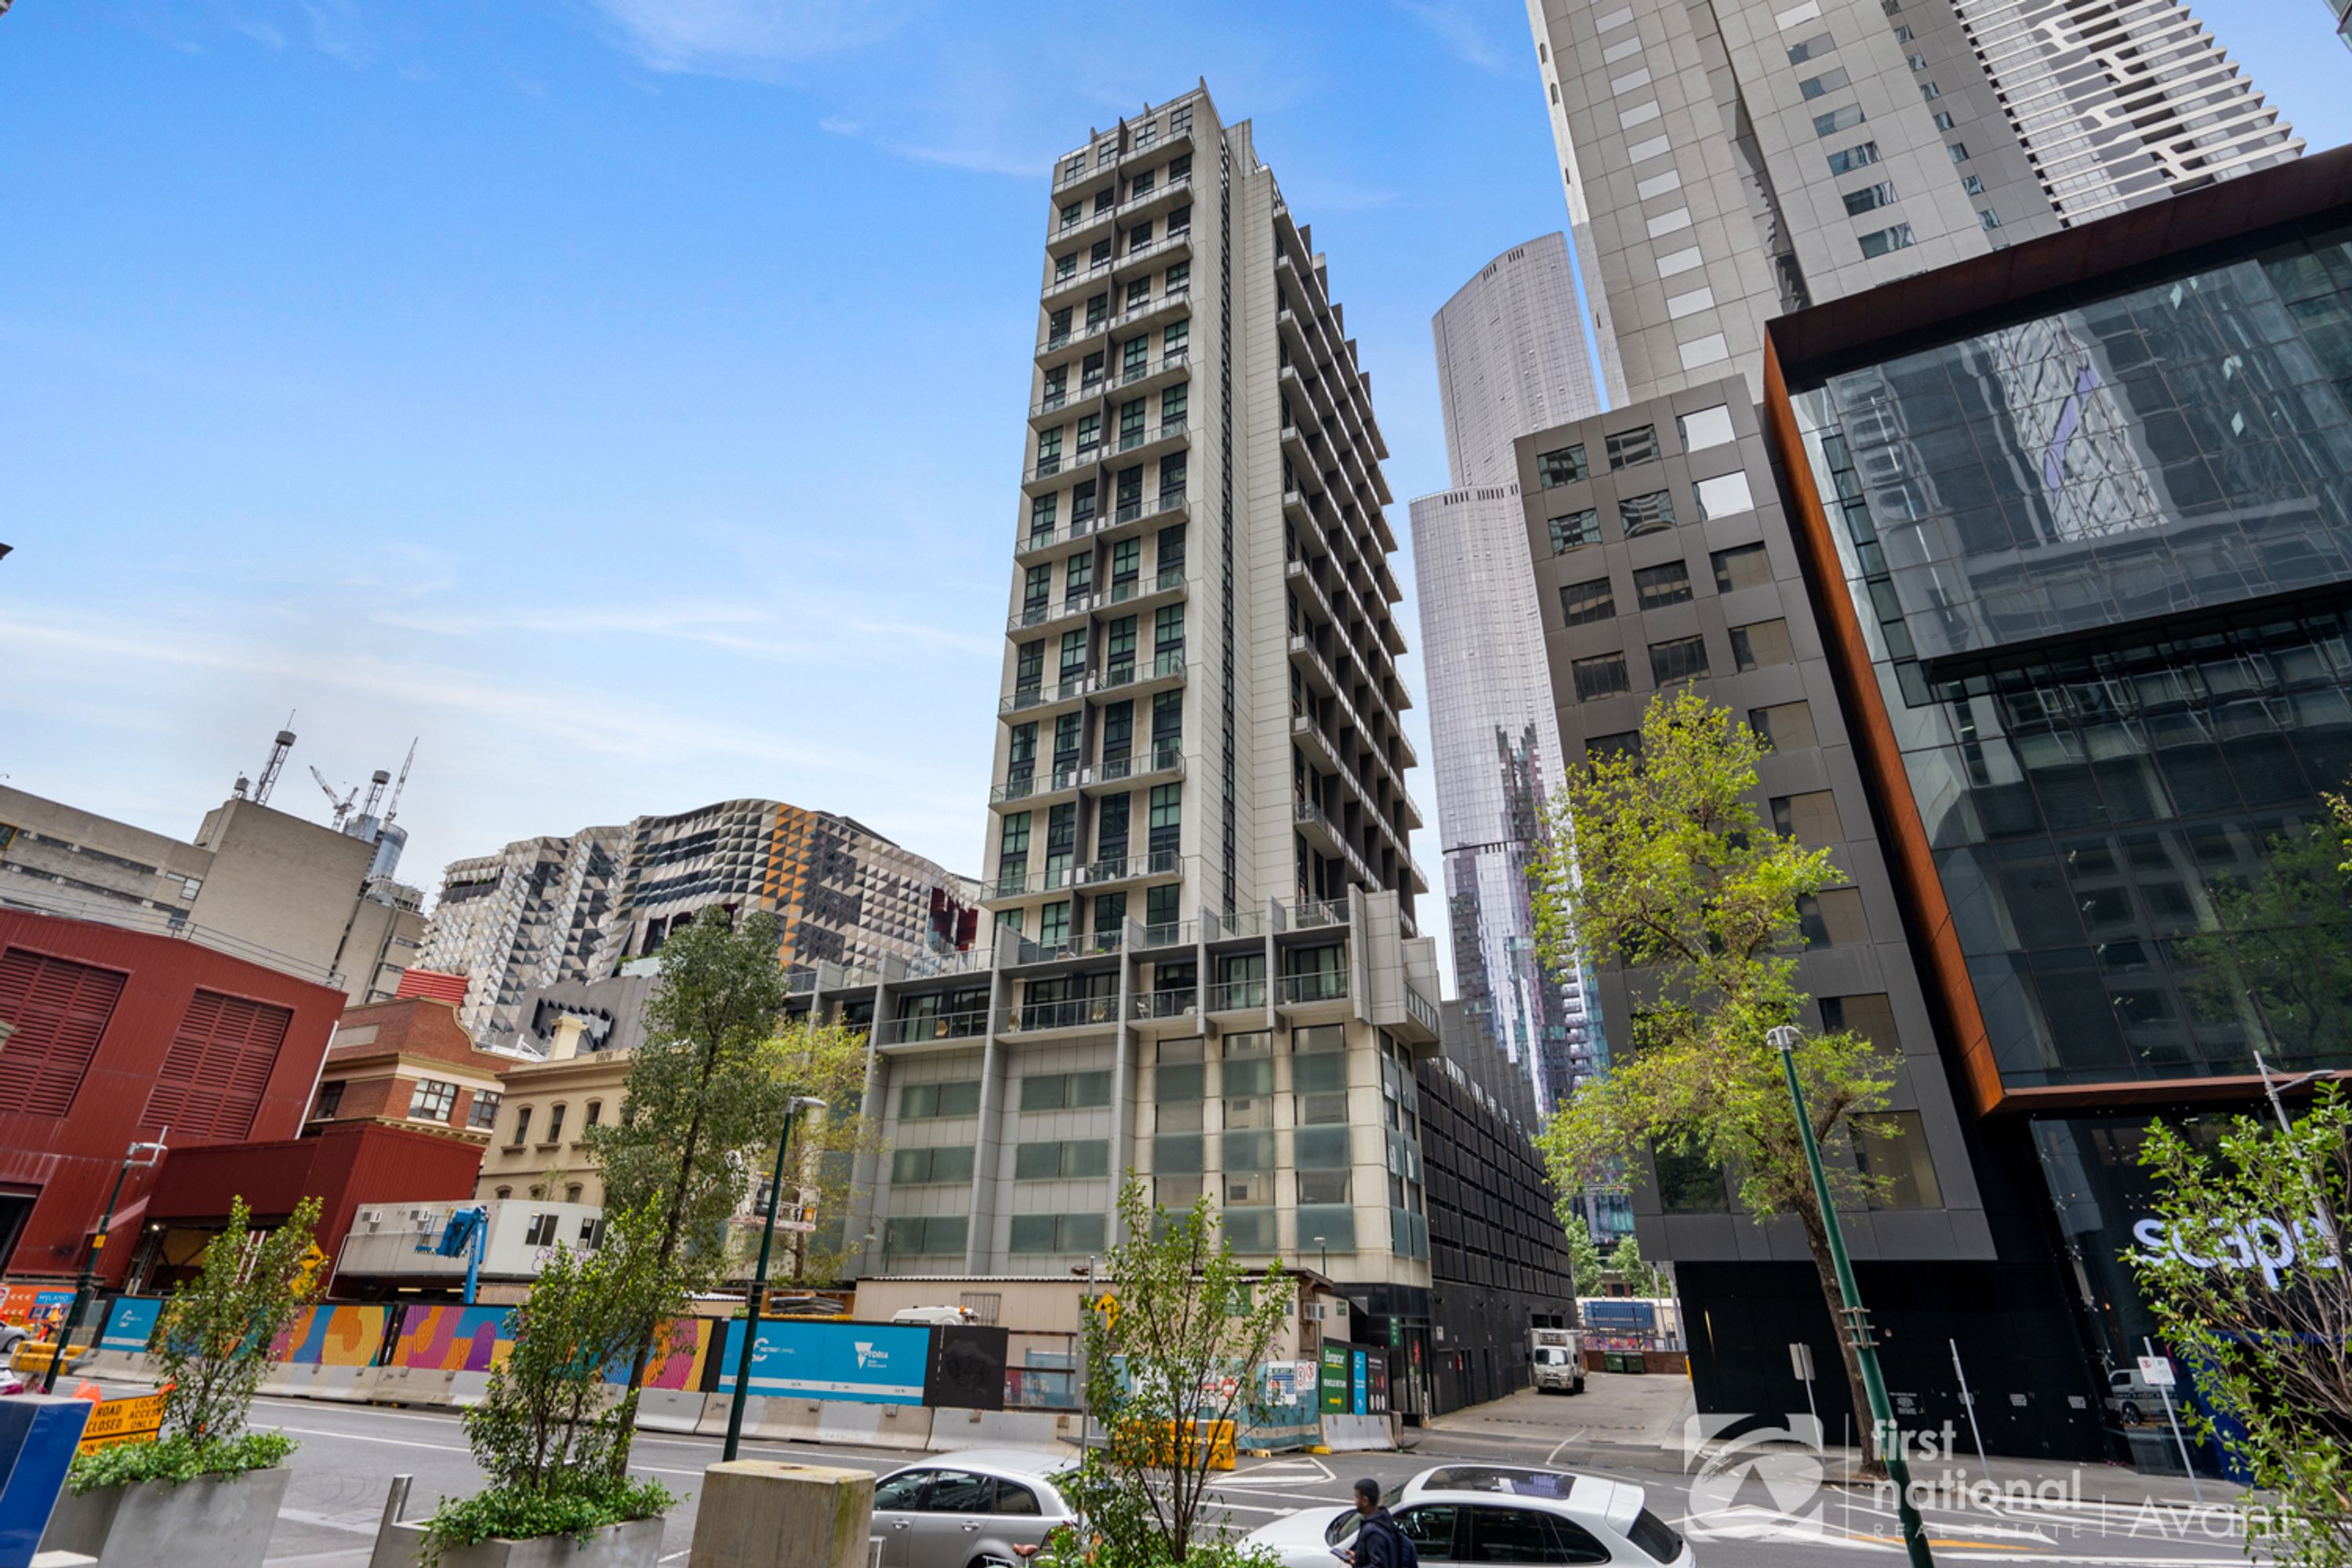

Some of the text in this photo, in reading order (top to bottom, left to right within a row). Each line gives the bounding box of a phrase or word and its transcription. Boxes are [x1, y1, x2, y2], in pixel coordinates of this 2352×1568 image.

[95, 1404, 122, 1417] ROAD
[85, 1418, 123, 1433] CLOSED
[129, 1419, 154, 1430] ONLY
